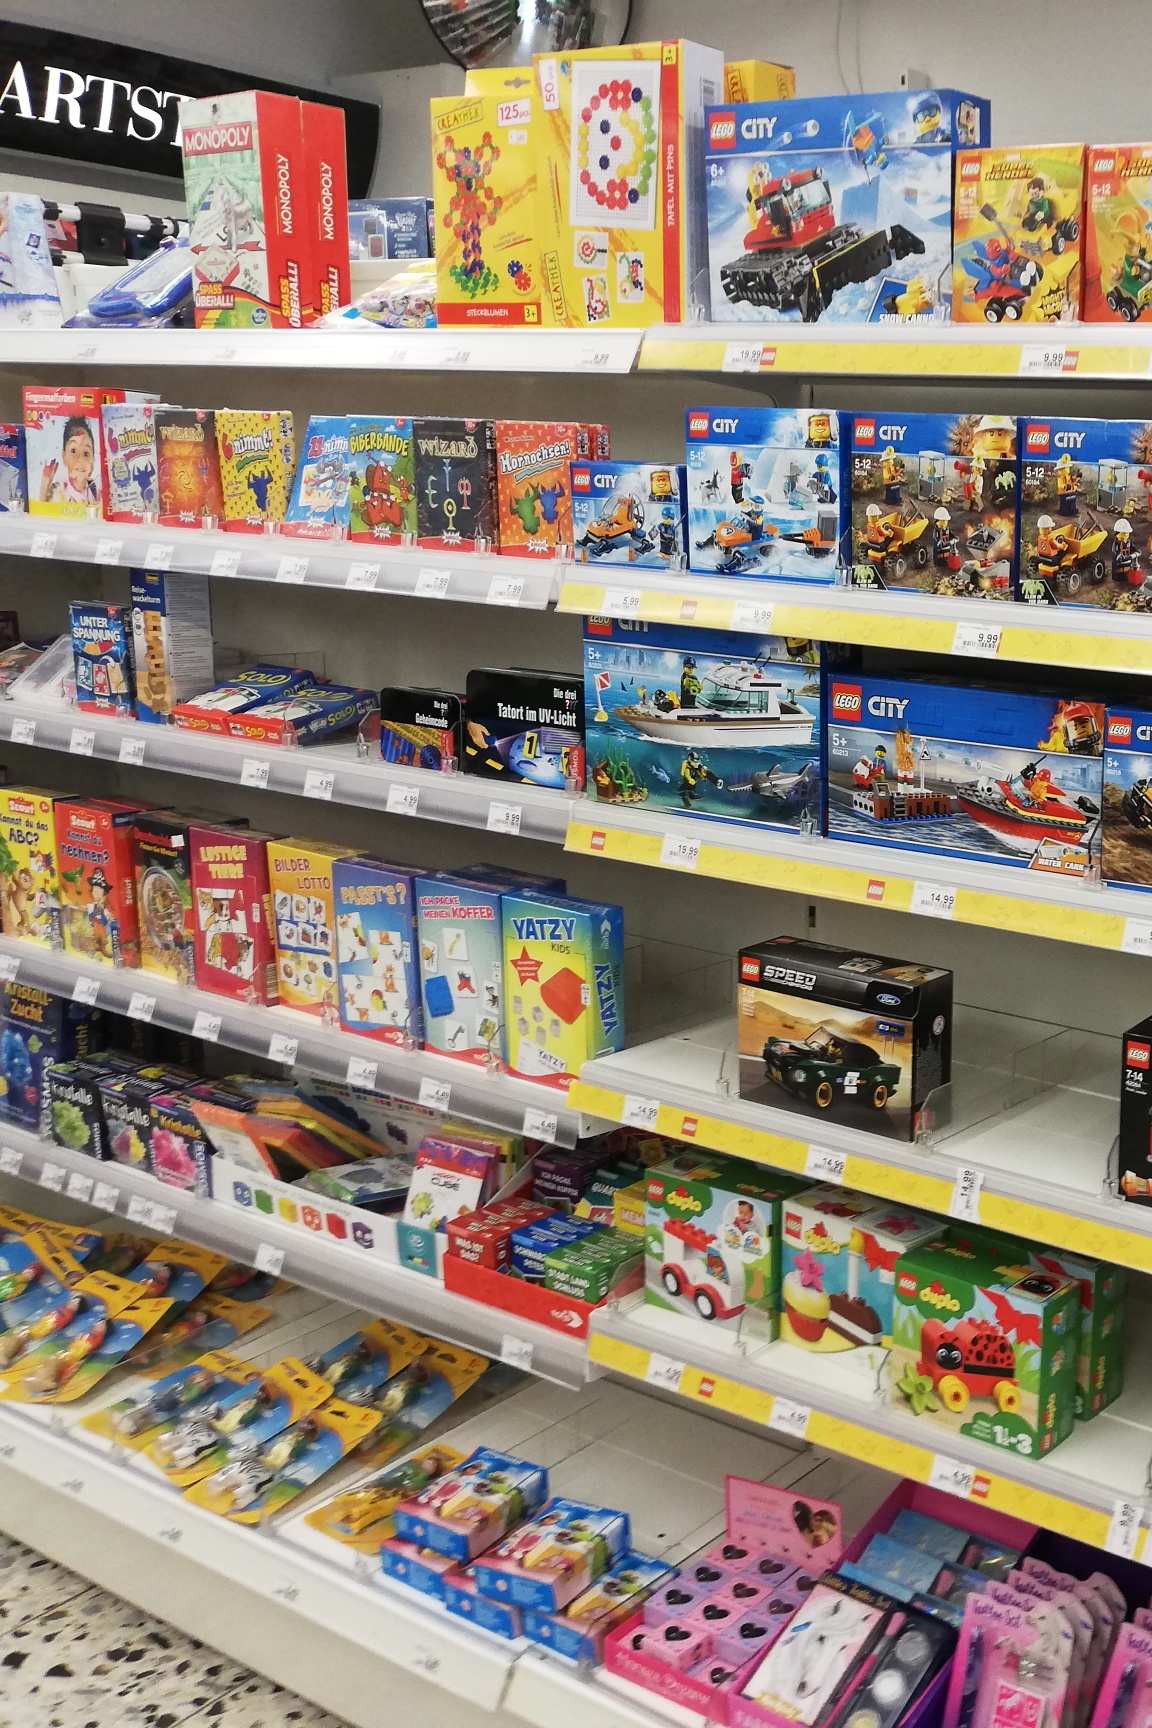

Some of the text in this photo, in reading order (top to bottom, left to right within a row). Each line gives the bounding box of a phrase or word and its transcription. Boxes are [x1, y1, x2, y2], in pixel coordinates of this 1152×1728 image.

[437, 107, 481, 131] CREATHEK
[710, 117, 777, 140] LEGO CITY
[185, 126, 251, 152] MONOPOLY
[710, 164, 724, 177] 6+
[961, 163, 980, 175] LEGO
[1093, 160, 1114, 171] LEGO
[277, 153, 293, 235] MONOPOLY
[667, 144, 675, 227] TAFEL MIT PINS
[320, 161, 333, 241] MONOPOLY
[288, 261, 301, 328] ÜBERALL!
[546, 254, 565, 318] CREATHEK
[279, 275, 290, 320] SPASS
[466, 306, 537, 319] STECKBLUMEN 3+
[25, 391, 76, 405] Fingermalfarben
[690, 418, 738, 434] LEGO CITY
[855, 424, 908, 441] LEGO CITY
[107, 427, 119, 455] 6
[221, 428, 275, 461] 6 nimmt!
[307, 435, 324, 458] 11
[350, 433, 409, 456] BIBERBANDE
[1027, 431, 1086, 449] LEGO CITY
[500, 441, 571, 474] Hornochsen!
[855, 458, 871, 470] 5-12
[574, 474, 618, 488] LEGO CITY
[1026, 466, 1045, 479] 5-12
[131, 595, 161, 604] wackelturm
[80, 615, 109, 629] UNTER
[73, 627, 121, 643] SPANNUNG
[588, 647, 602, 661] 5+
[553, 687, 577, 700] Die drei
[497, 702, 577, 727] Tatort im UV-Licht
[833, 693, 910, 719] LEGO CITY
[189, 717, 210, 730] SOLO
[415, 712, 448, 728] Geheimcode
[244, 726, 266, 739] SOLO
[1109, 723, 1131, 736] LEGO
[832, 732, 848, 748] 5+
[1107, 758, 1119, 769] 5+
[8, 800, 36, 815] Scout
[70, 814, 96, 829] Scout
[8, 828, 40, 846] ABC?
[61, 844, 111, 865] rechnen?
[199, 845, 248, 863] LUSTIGE
[678, 844, 699, 857] 19.99
[208, 863, 245, 880] TIERE
[274, 858, 311, 873] BILDER
[296, 874, 331, 892] LOTTO
[124, 878, 133, 906] Scout
[339, 882, 406, 906] PASST'S?
[930, 892, 955, 906] 14.99
[420, 895, 460, 908] ICH PACKE
[423, 905, 496, 922] MEINEN KOFFER
[511, 916, 577, 943] YATZY
[550, 942, 572, 956] KIDS
[742, 963, 759, 977] LEGO
[763, 964, 817, 987] SPEED
[593, 962, 620, 1038] YATZY
[10, 997, 45, 1023] Zucht
[1127, 1048, 1149, 1061] LEGO
[1125, 1069, 1144, 1082] 7-14
